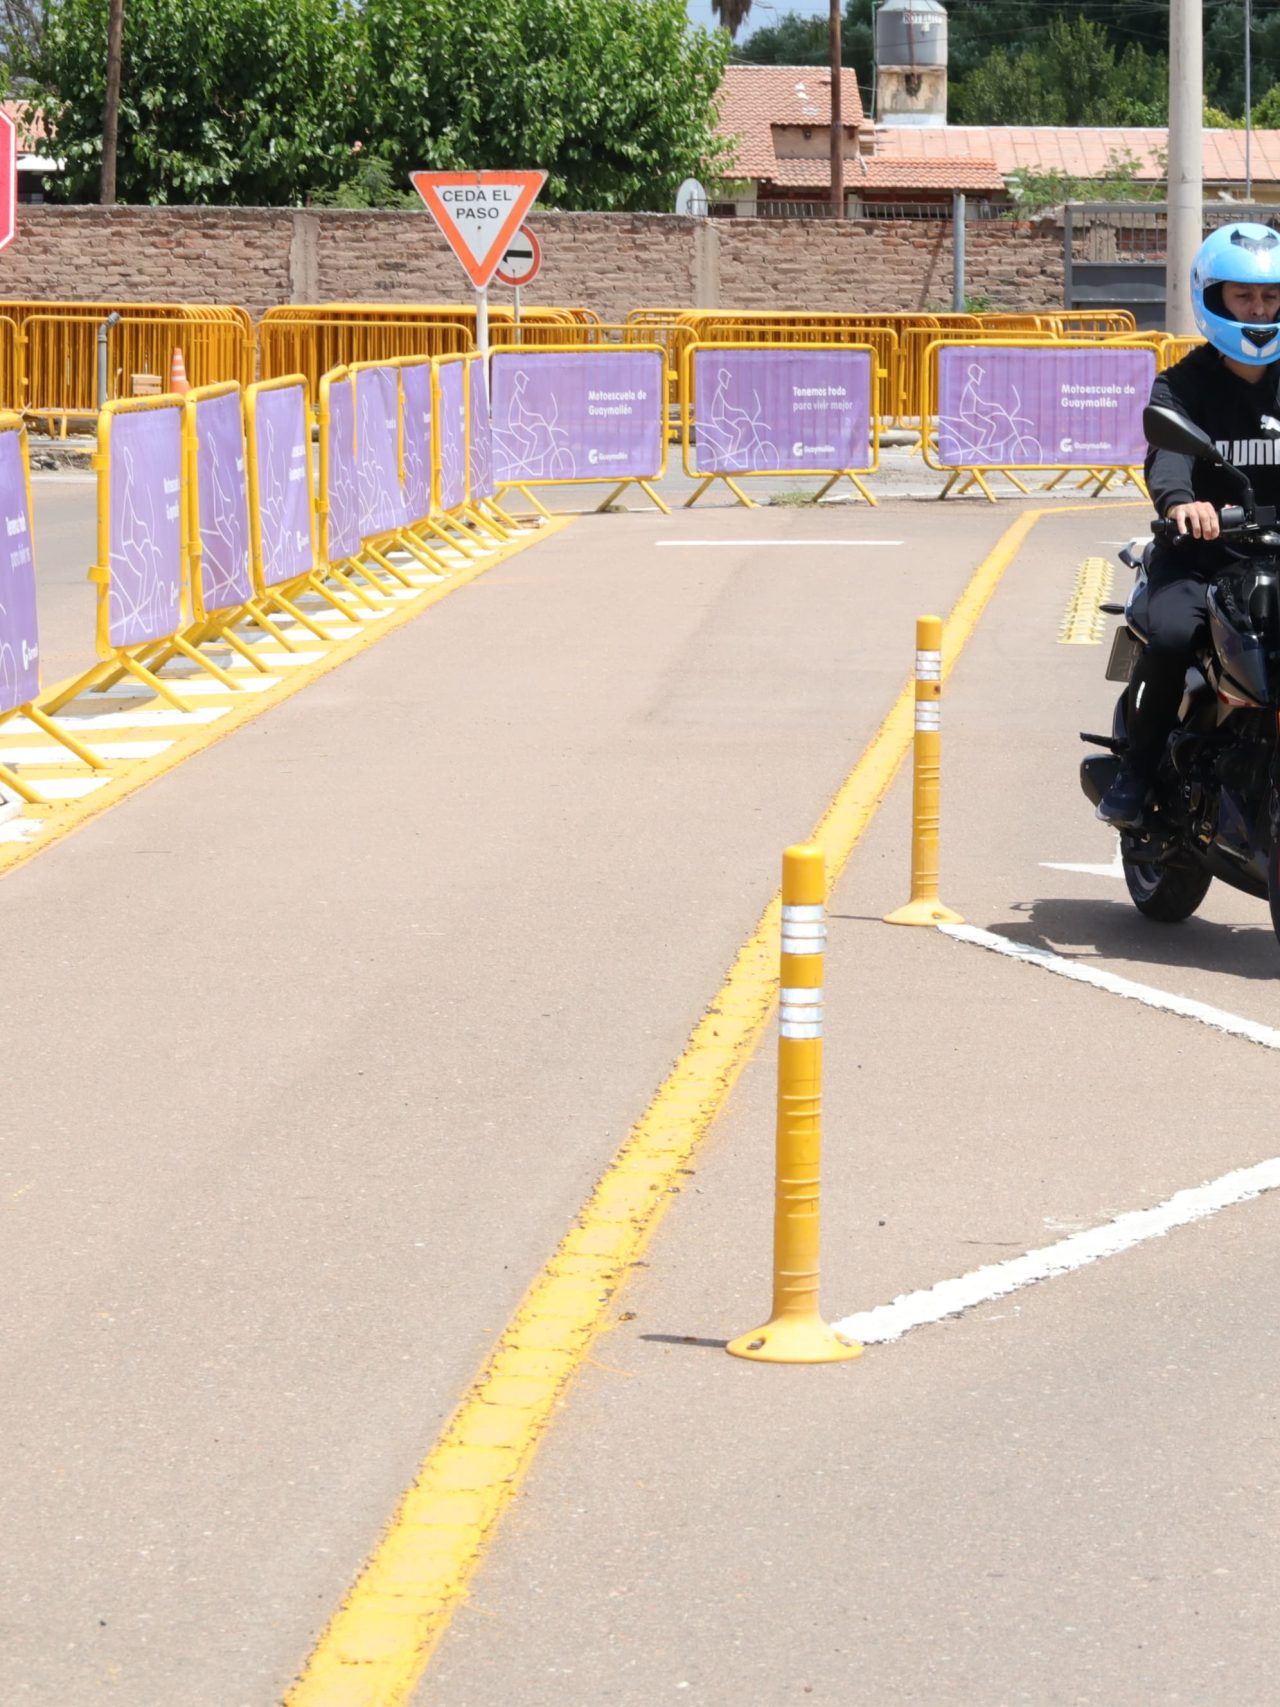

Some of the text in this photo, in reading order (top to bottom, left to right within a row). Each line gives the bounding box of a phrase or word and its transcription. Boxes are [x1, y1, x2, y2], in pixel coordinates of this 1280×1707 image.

[442, 189, 512, 202] CEDA EL
[456, 207, 500, 219] PASO
[588, 389, 647, 401] Motoescuela de
[792, 385, 847, 397] Tenemos todo
[1061, 384, 1136, 394] Motoescuela de
[792, 399, 853, 413] para vivir mejor
[1061, 397, 1118, 410] Guaymallén
[588, 403, 633, 418] Guaymallén
